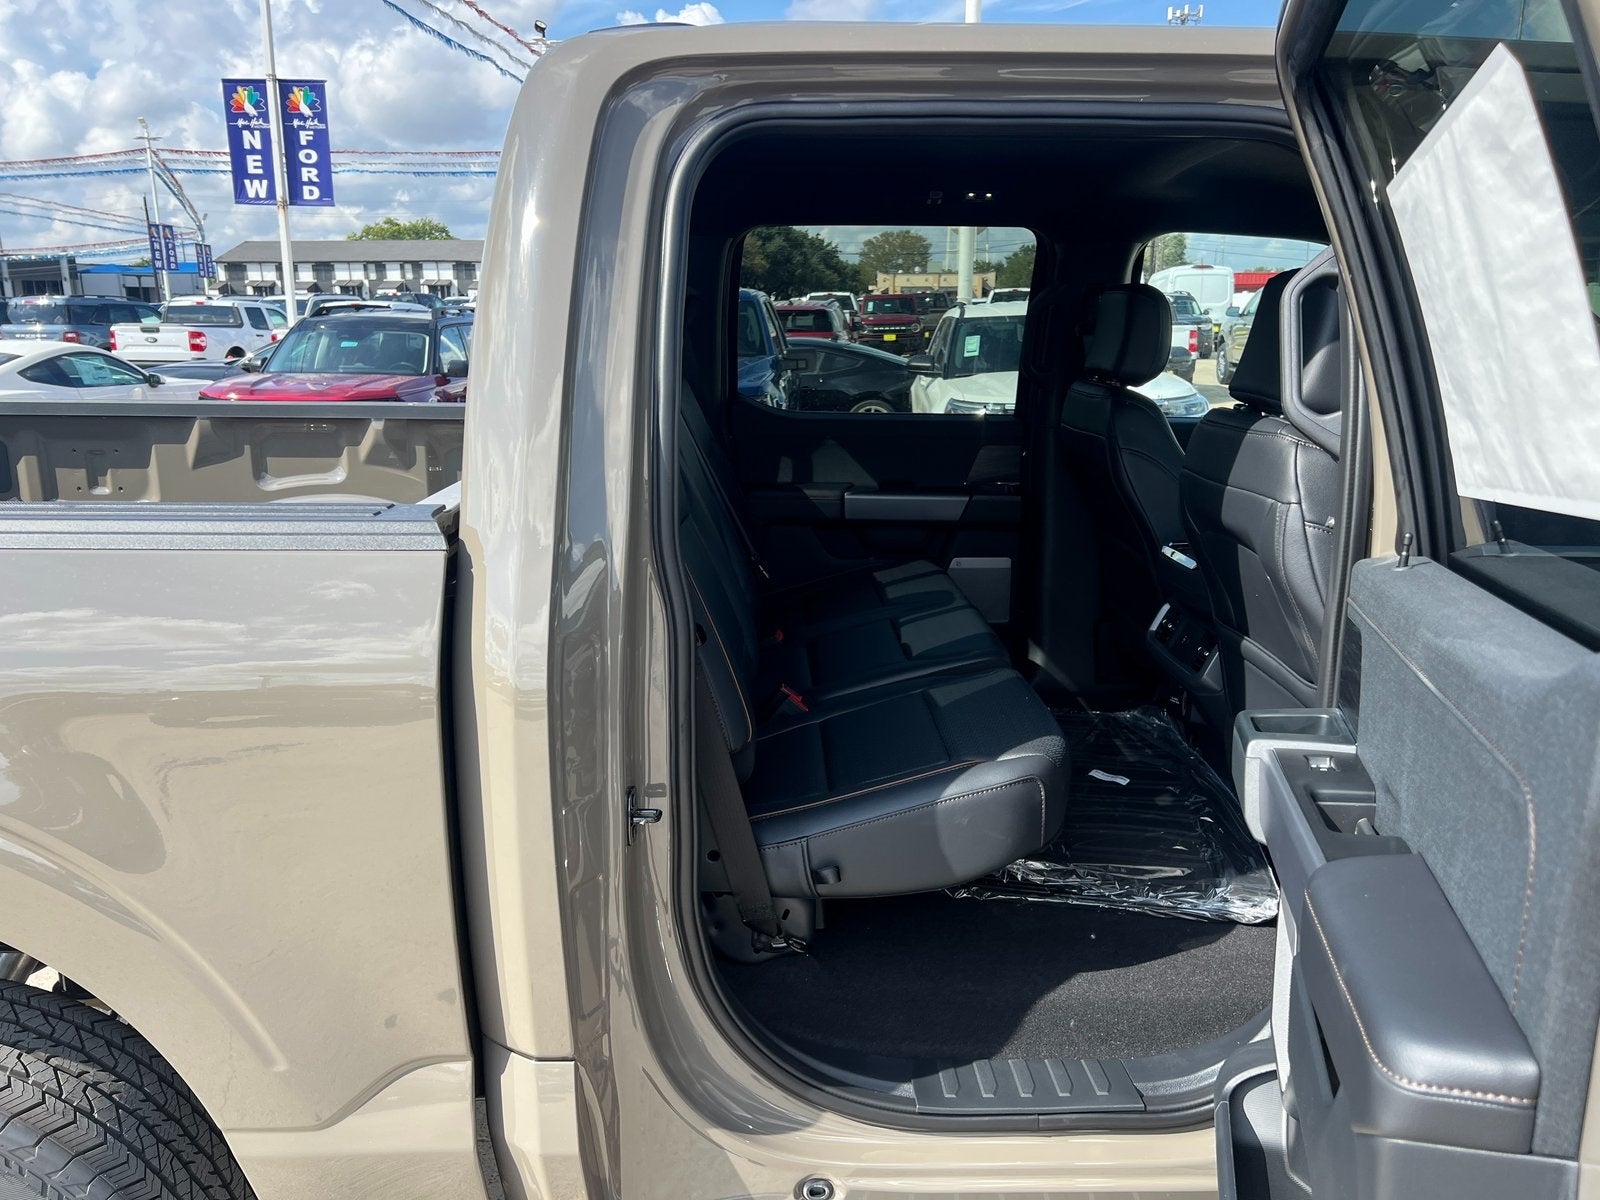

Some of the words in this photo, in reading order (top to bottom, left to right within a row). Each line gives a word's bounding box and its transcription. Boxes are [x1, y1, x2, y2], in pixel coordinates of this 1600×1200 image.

[242, 130, 268, 199] NEW
[298, 131, 320, 200] FORD
[153, 242, 162, 268] NEW
